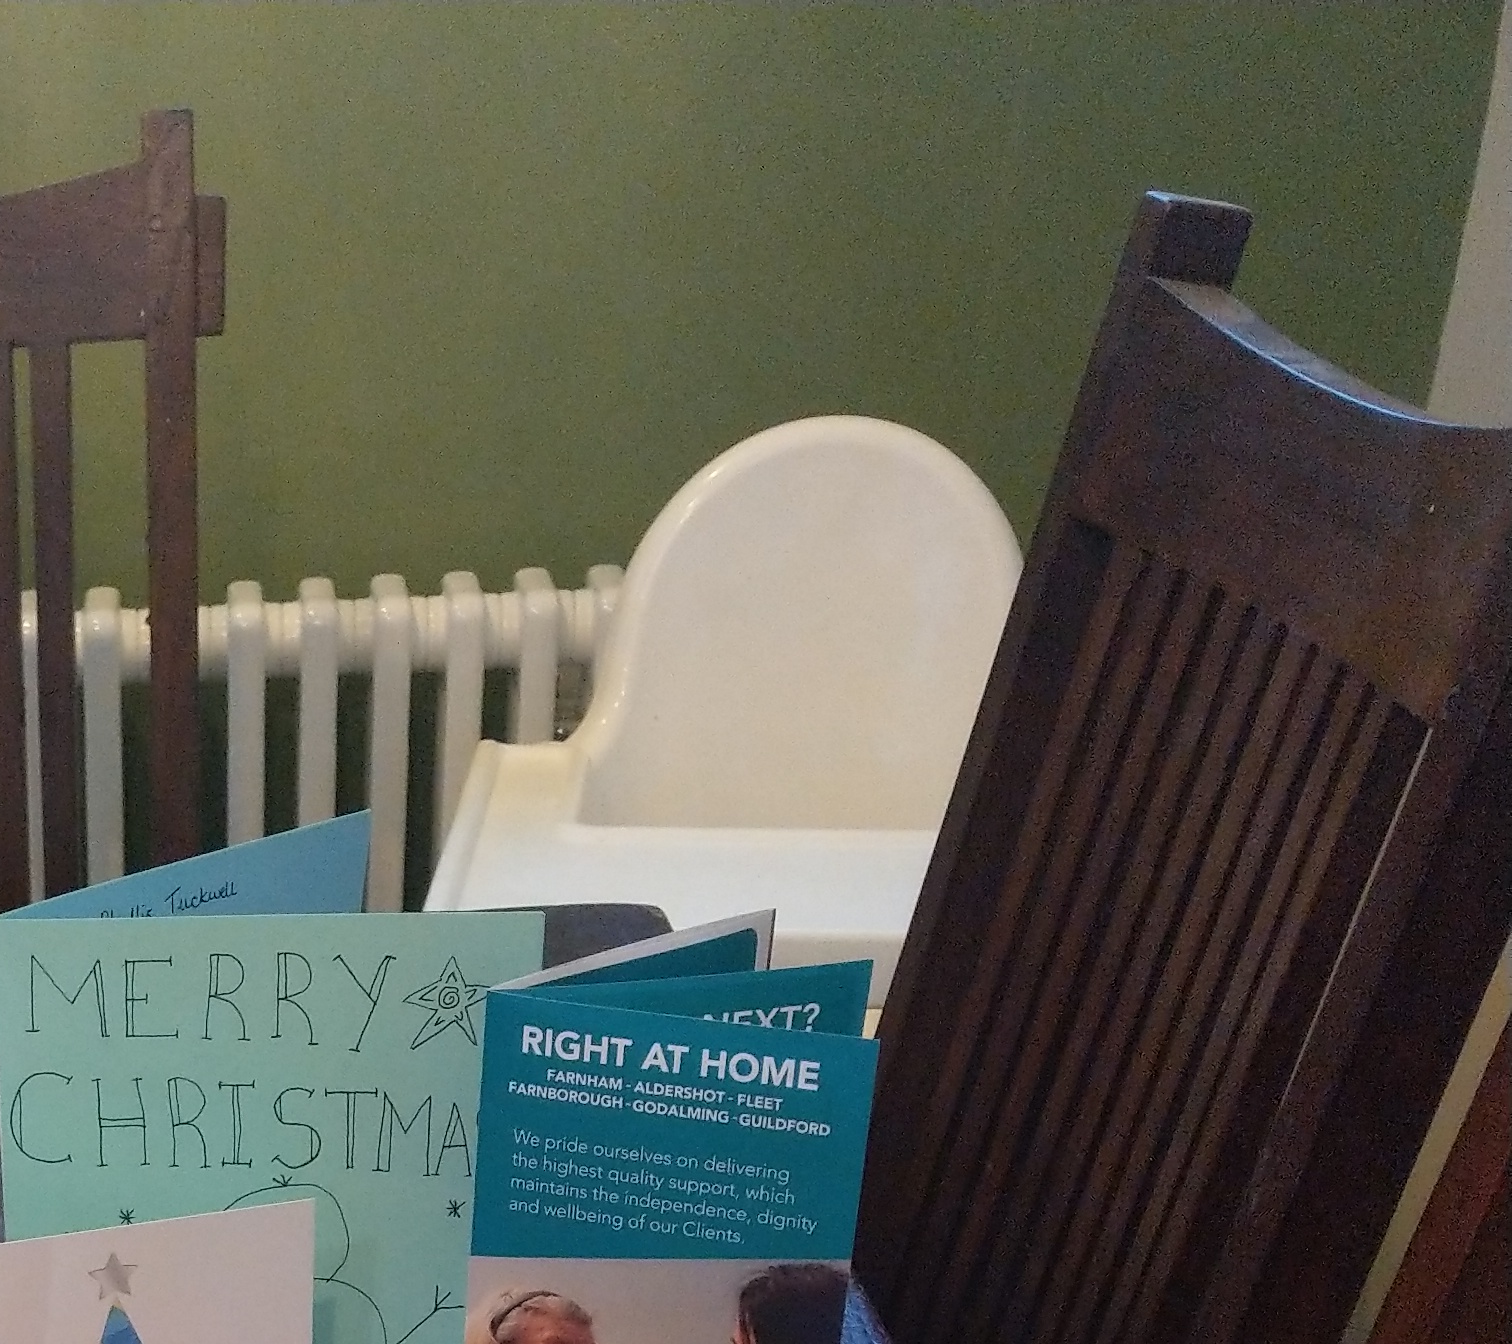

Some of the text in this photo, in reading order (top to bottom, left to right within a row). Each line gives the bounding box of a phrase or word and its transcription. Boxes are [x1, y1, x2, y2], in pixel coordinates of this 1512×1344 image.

[26, 952, 396, 1052] MERRY
[522, 1025, 820, 1092] RIGHT AT HOME
[508, 1081, 623, 1109] FARNBOROUGH
[633, 1099, 729, 1124] GODALMING
[738, 1114, 831, 1137] GUILDFORD
[546, 1068, 622, 1091] FARNHAM
[634, 1083, 725, 1104] ALDERSHOT
[737, 1093, 784, 1112] FLEET
[10, 1071, 472, 1178] CHRISTMA
[512, 1153, 795, 1205] the highest quality support, which
[513, 1128, 789, 1185] We pride ourselves on delivering
[509, 1198, 539, 1214] and
[544, 1203, 623, 1231] wellbeing
[628, 1213, 646, 1229] of
[649, 1218, 678, 1234] our
[510, 1177, 818, 1235] maintains the independence, dignity
